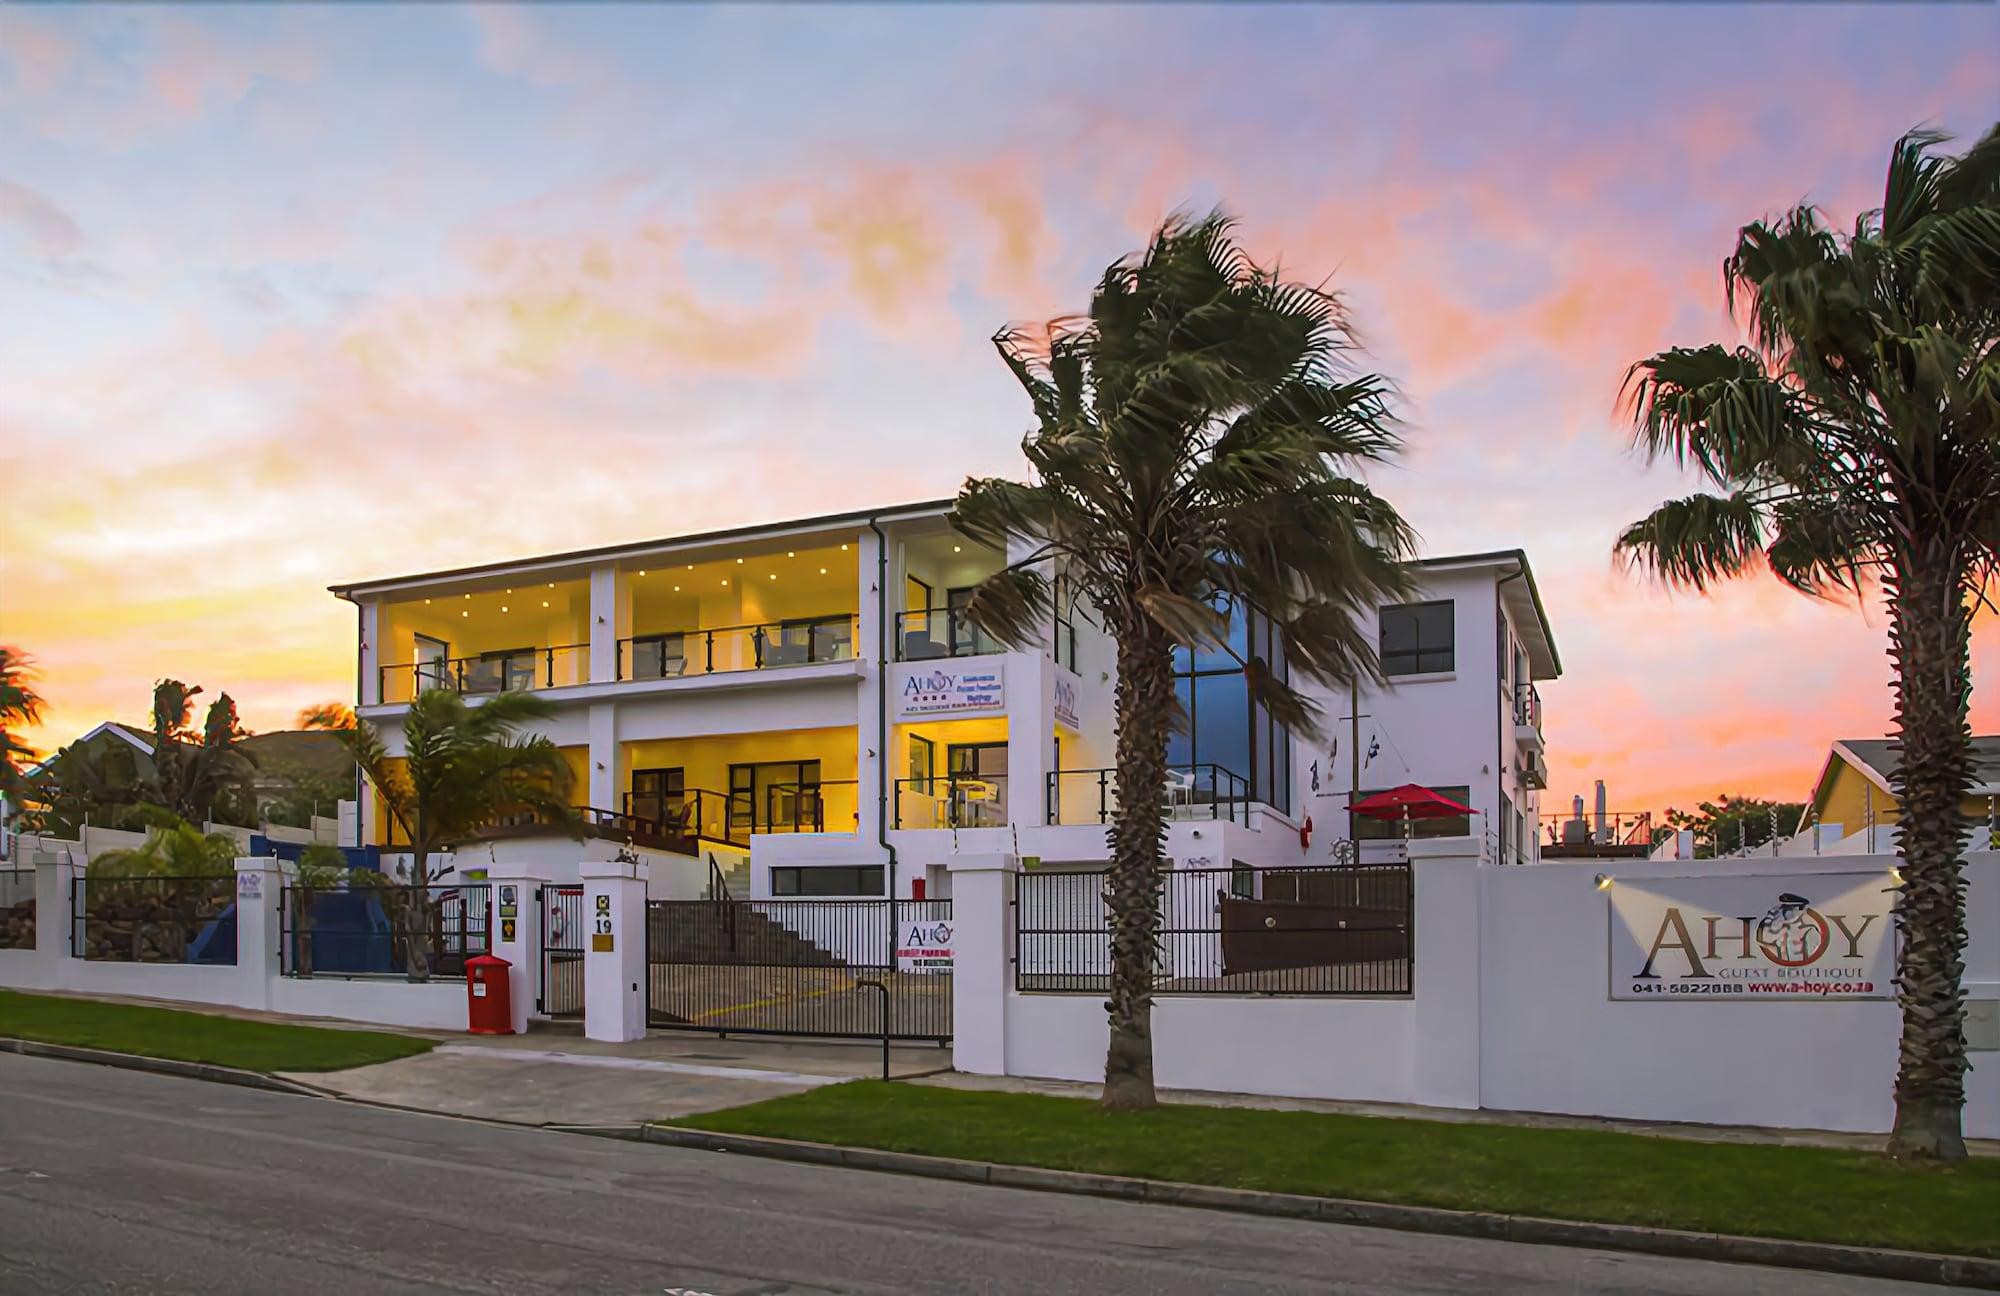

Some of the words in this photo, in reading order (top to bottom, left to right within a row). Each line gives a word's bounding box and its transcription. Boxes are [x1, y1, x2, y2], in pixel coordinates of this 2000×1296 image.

[904, 674, 957, 696] AHOY
[596, 920, 611, 933] 19
[907, 923, 953, 946] AHO
[1633, 906, 1879, 978] AHOY
[1719, 968, 1769, 979] GUEST
[1777, 968, 1863, 978] BOUTIQUE
[1748, 981, 1873, 996] www.a-hoy.co.za
